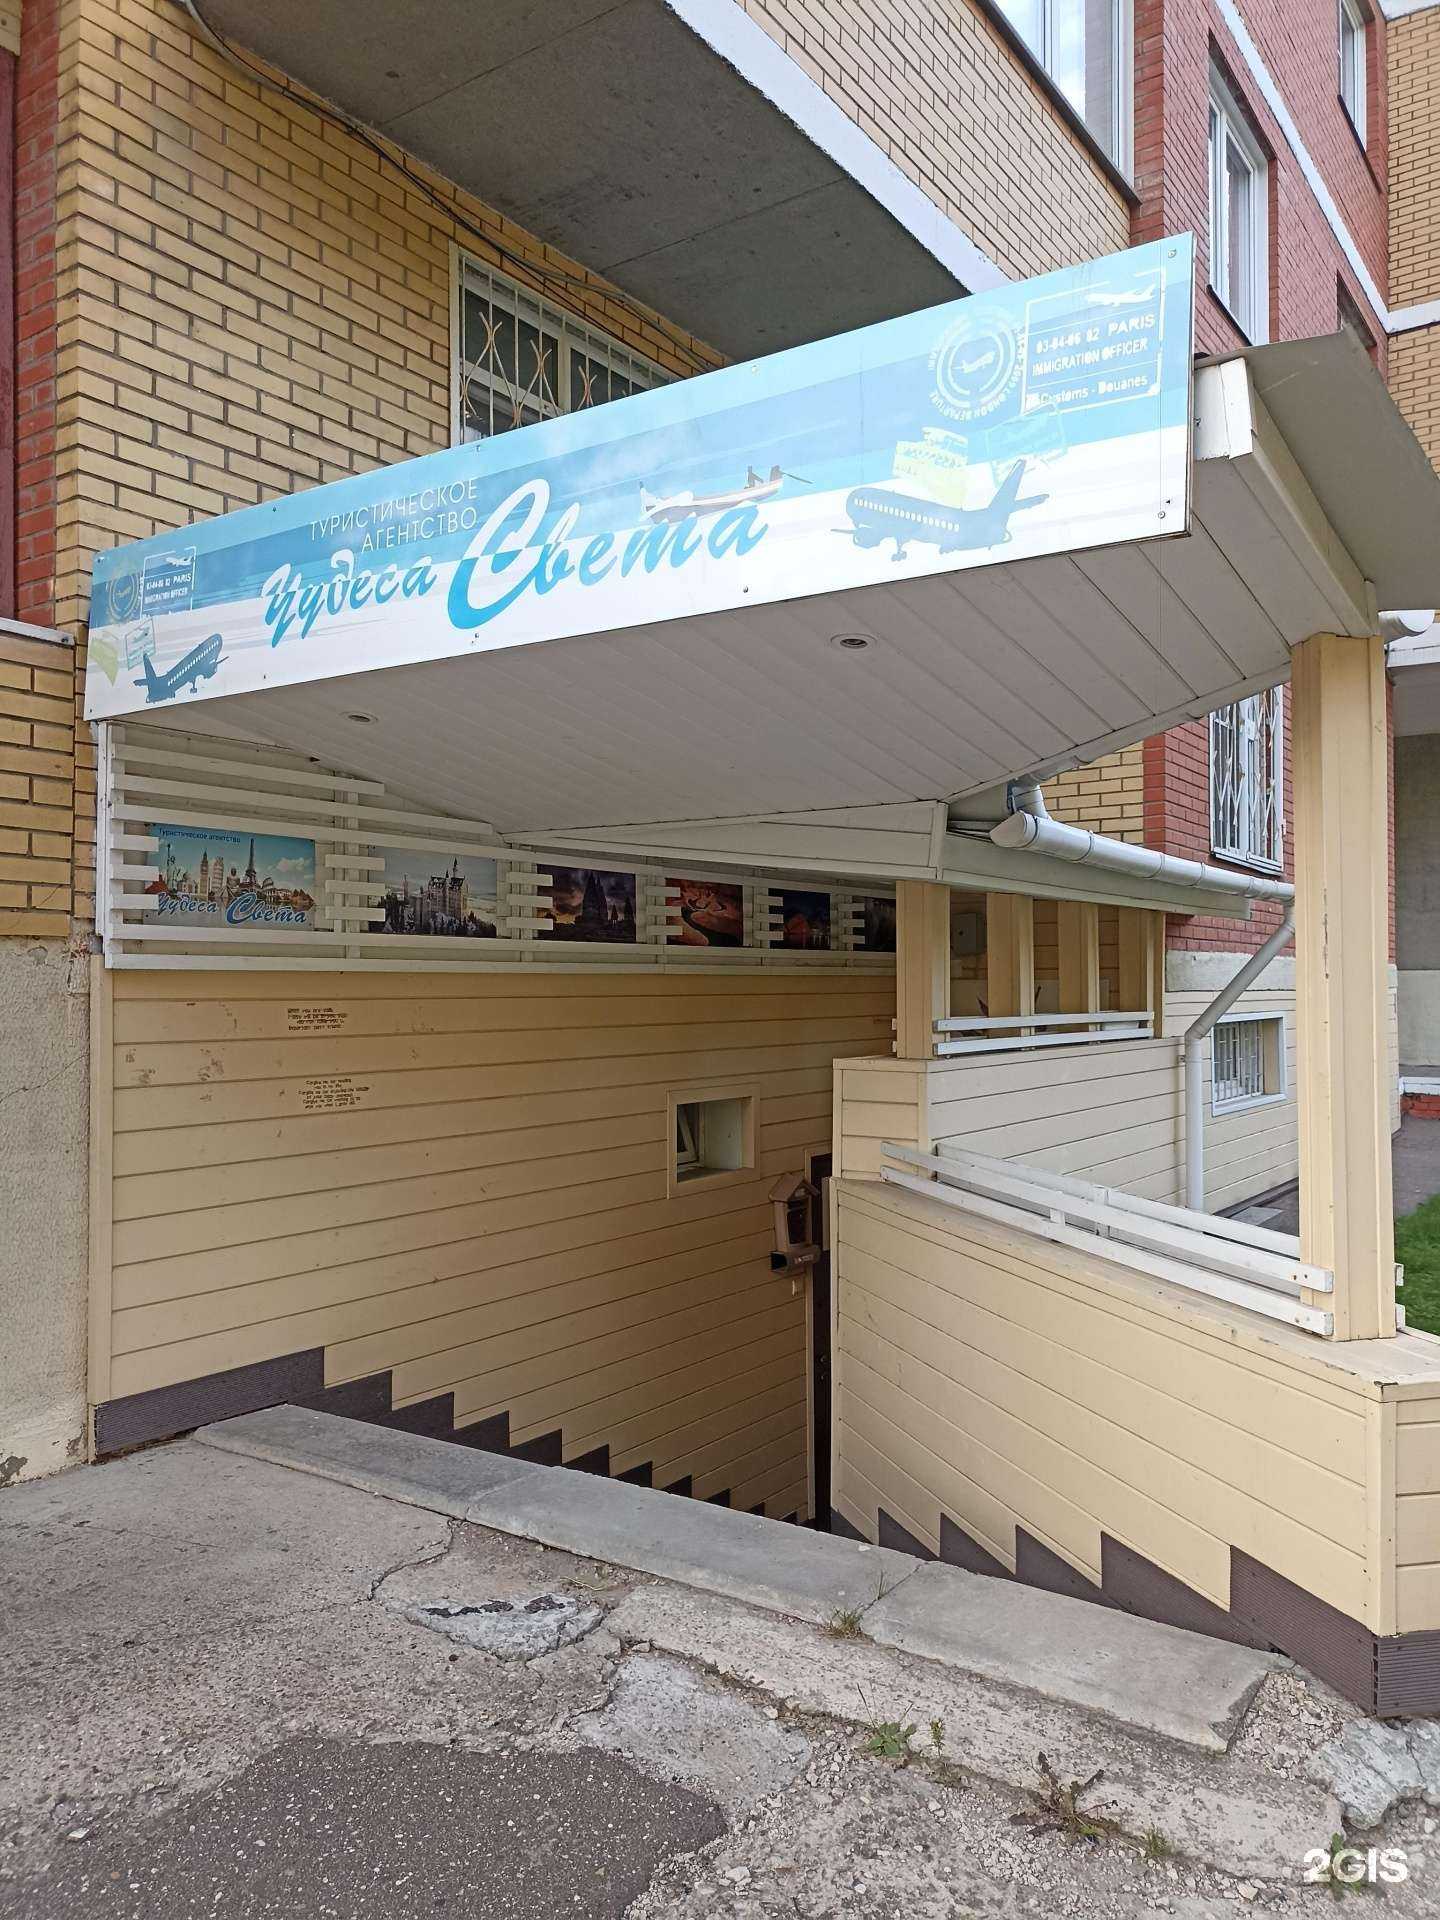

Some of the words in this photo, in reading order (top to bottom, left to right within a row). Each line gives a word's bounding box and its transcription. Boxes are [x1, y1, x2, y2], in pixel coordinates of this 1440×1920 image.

[1108, 313, 1155, 337] PARIS
[1032, 349, 1100, 377] IMMIGRATION
[1101, 338, 1148, 359] OFFICER
[1098, 374, 1149, 395] Douanes
[309, 477, 479, 542] ТУРИСТИЧЕСКОЕ
[360, 506, 478, 555] АГЕНТСТВО
[173, 573, 192, 584] PARIS
[261, 549, 437, 648] Чудеса
[447, 478, 770, 630] Света
[159, 828, 208, 841] Туристическое
[208, 834, 242, 844] агентство
[158, 891, 218, 916] Чудеса
[225, 891, 308, 925] Света
